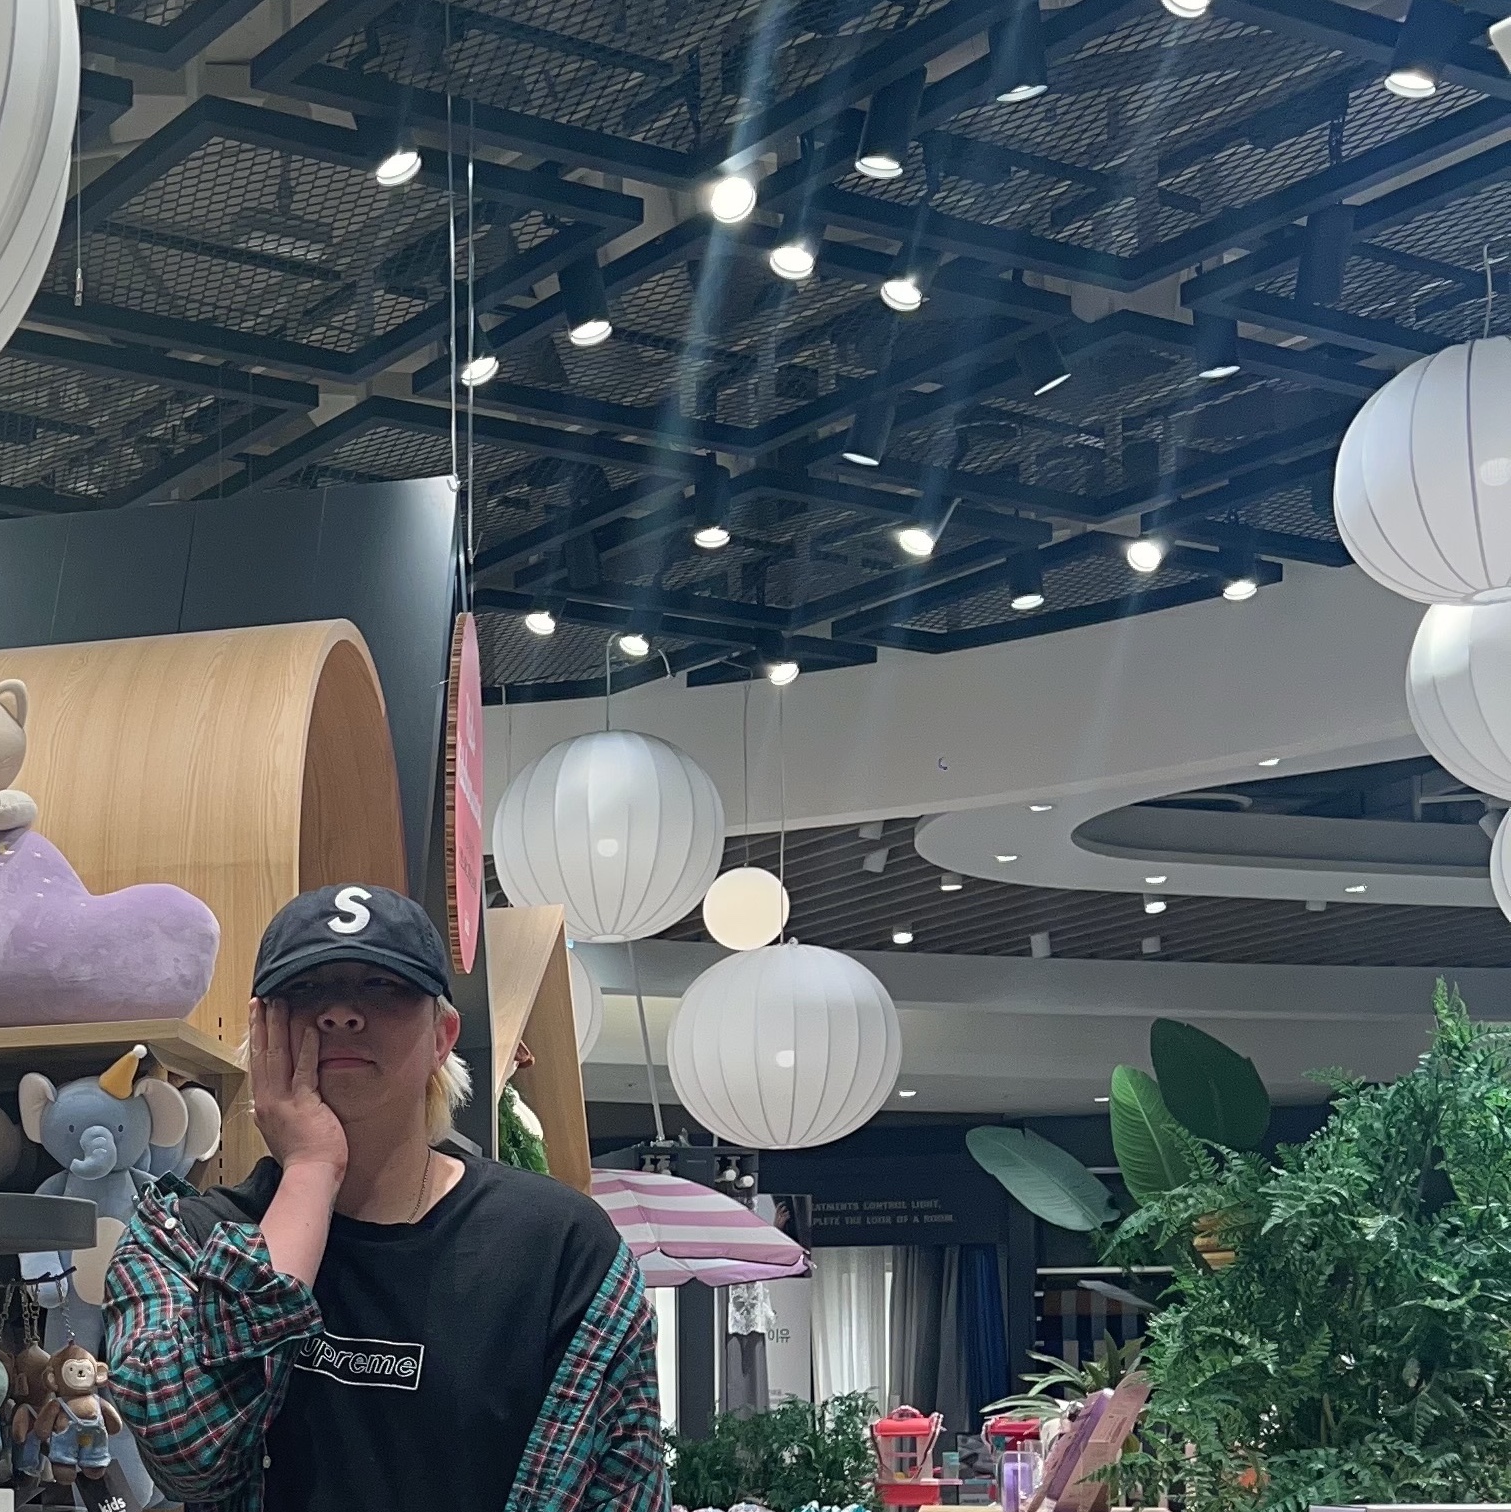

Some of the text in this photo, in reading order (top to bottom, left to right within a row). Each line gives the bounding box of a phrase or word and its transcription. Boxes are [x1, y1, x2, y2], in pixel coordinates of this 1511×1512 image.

[327, 886, 372, 933] S
[812, 1202, 859, 1211] ATMENTS
[812, 1216, 840, 1226] PLETE
[767, 1328, 790, 1343] 이유
[299, 1338, 417, 1377] upreme
